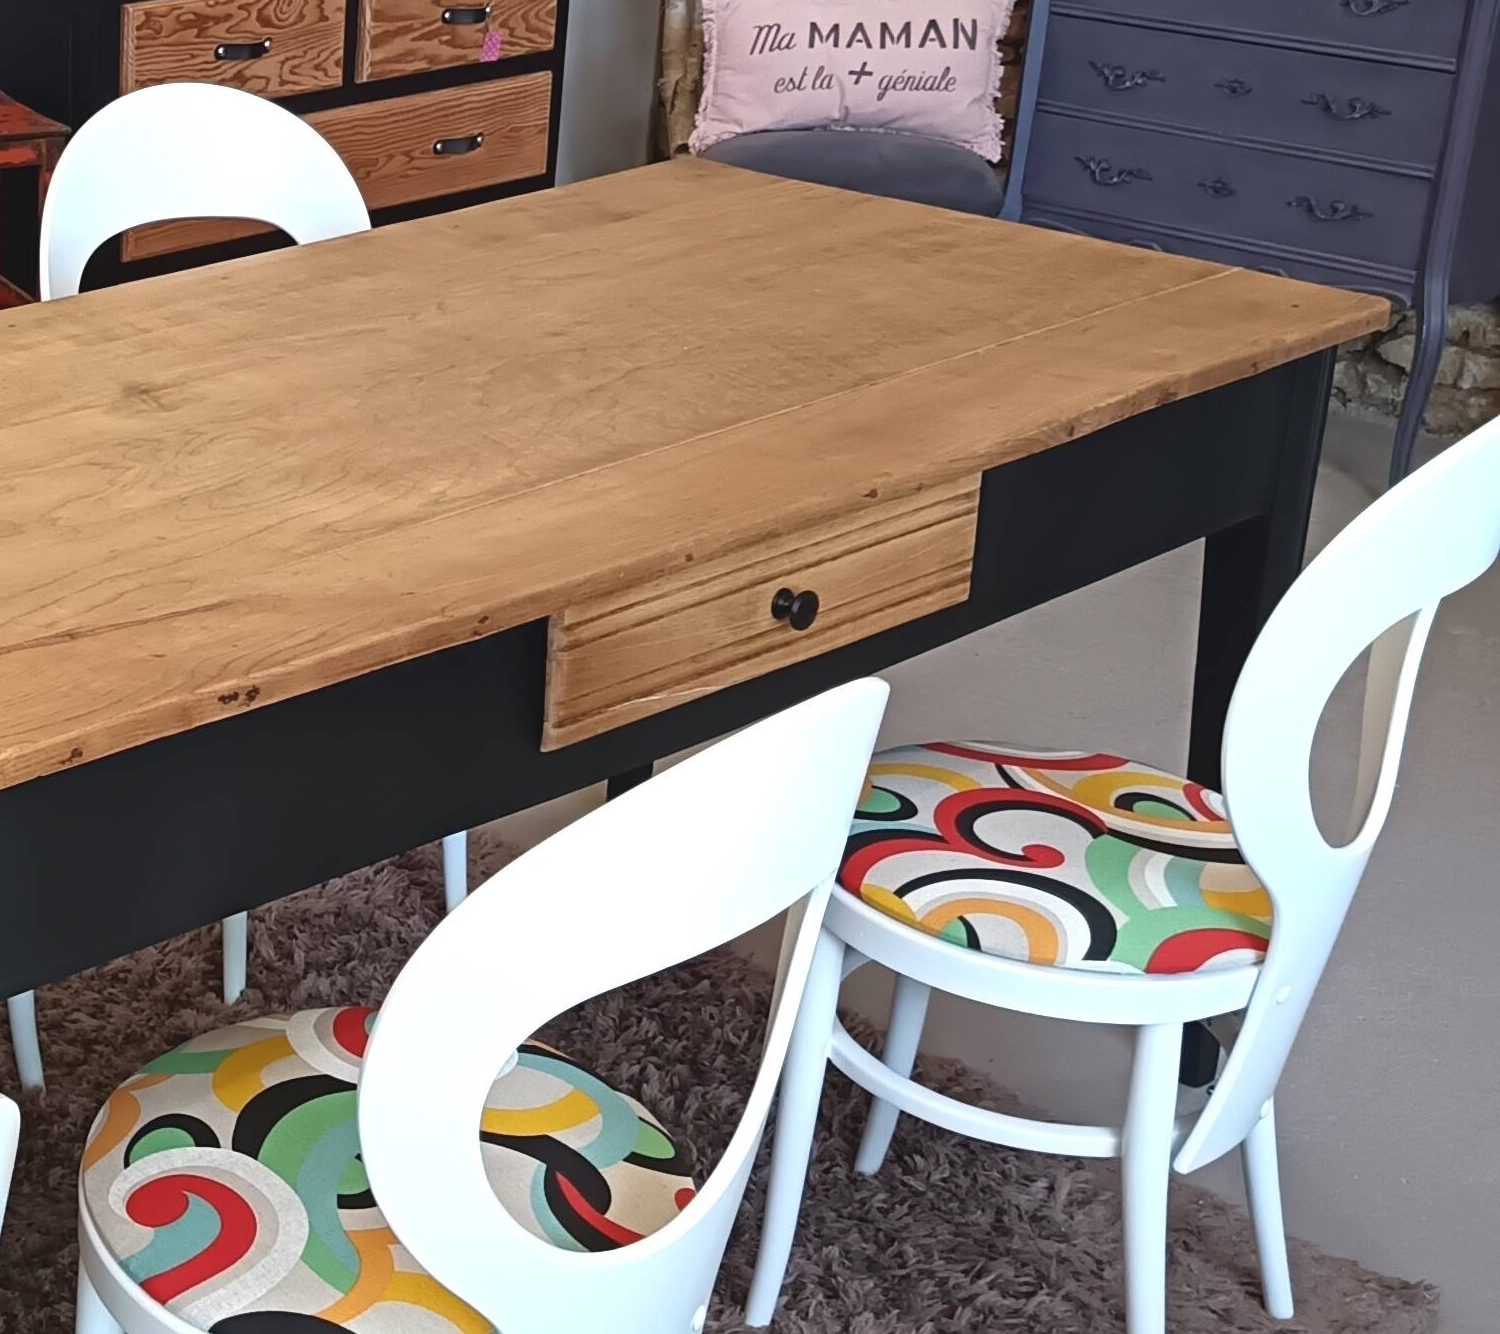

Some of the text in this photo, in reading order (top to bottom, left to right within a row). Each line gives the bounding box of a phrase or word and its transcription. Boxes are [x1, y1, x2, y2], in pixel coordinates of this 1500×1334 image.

[749, 18, 978, 57] Ma MAMAN
[774, 65, 807, 94] est
[811, 63, 834, 92] la
[877, 65, 956, 101] géniale
